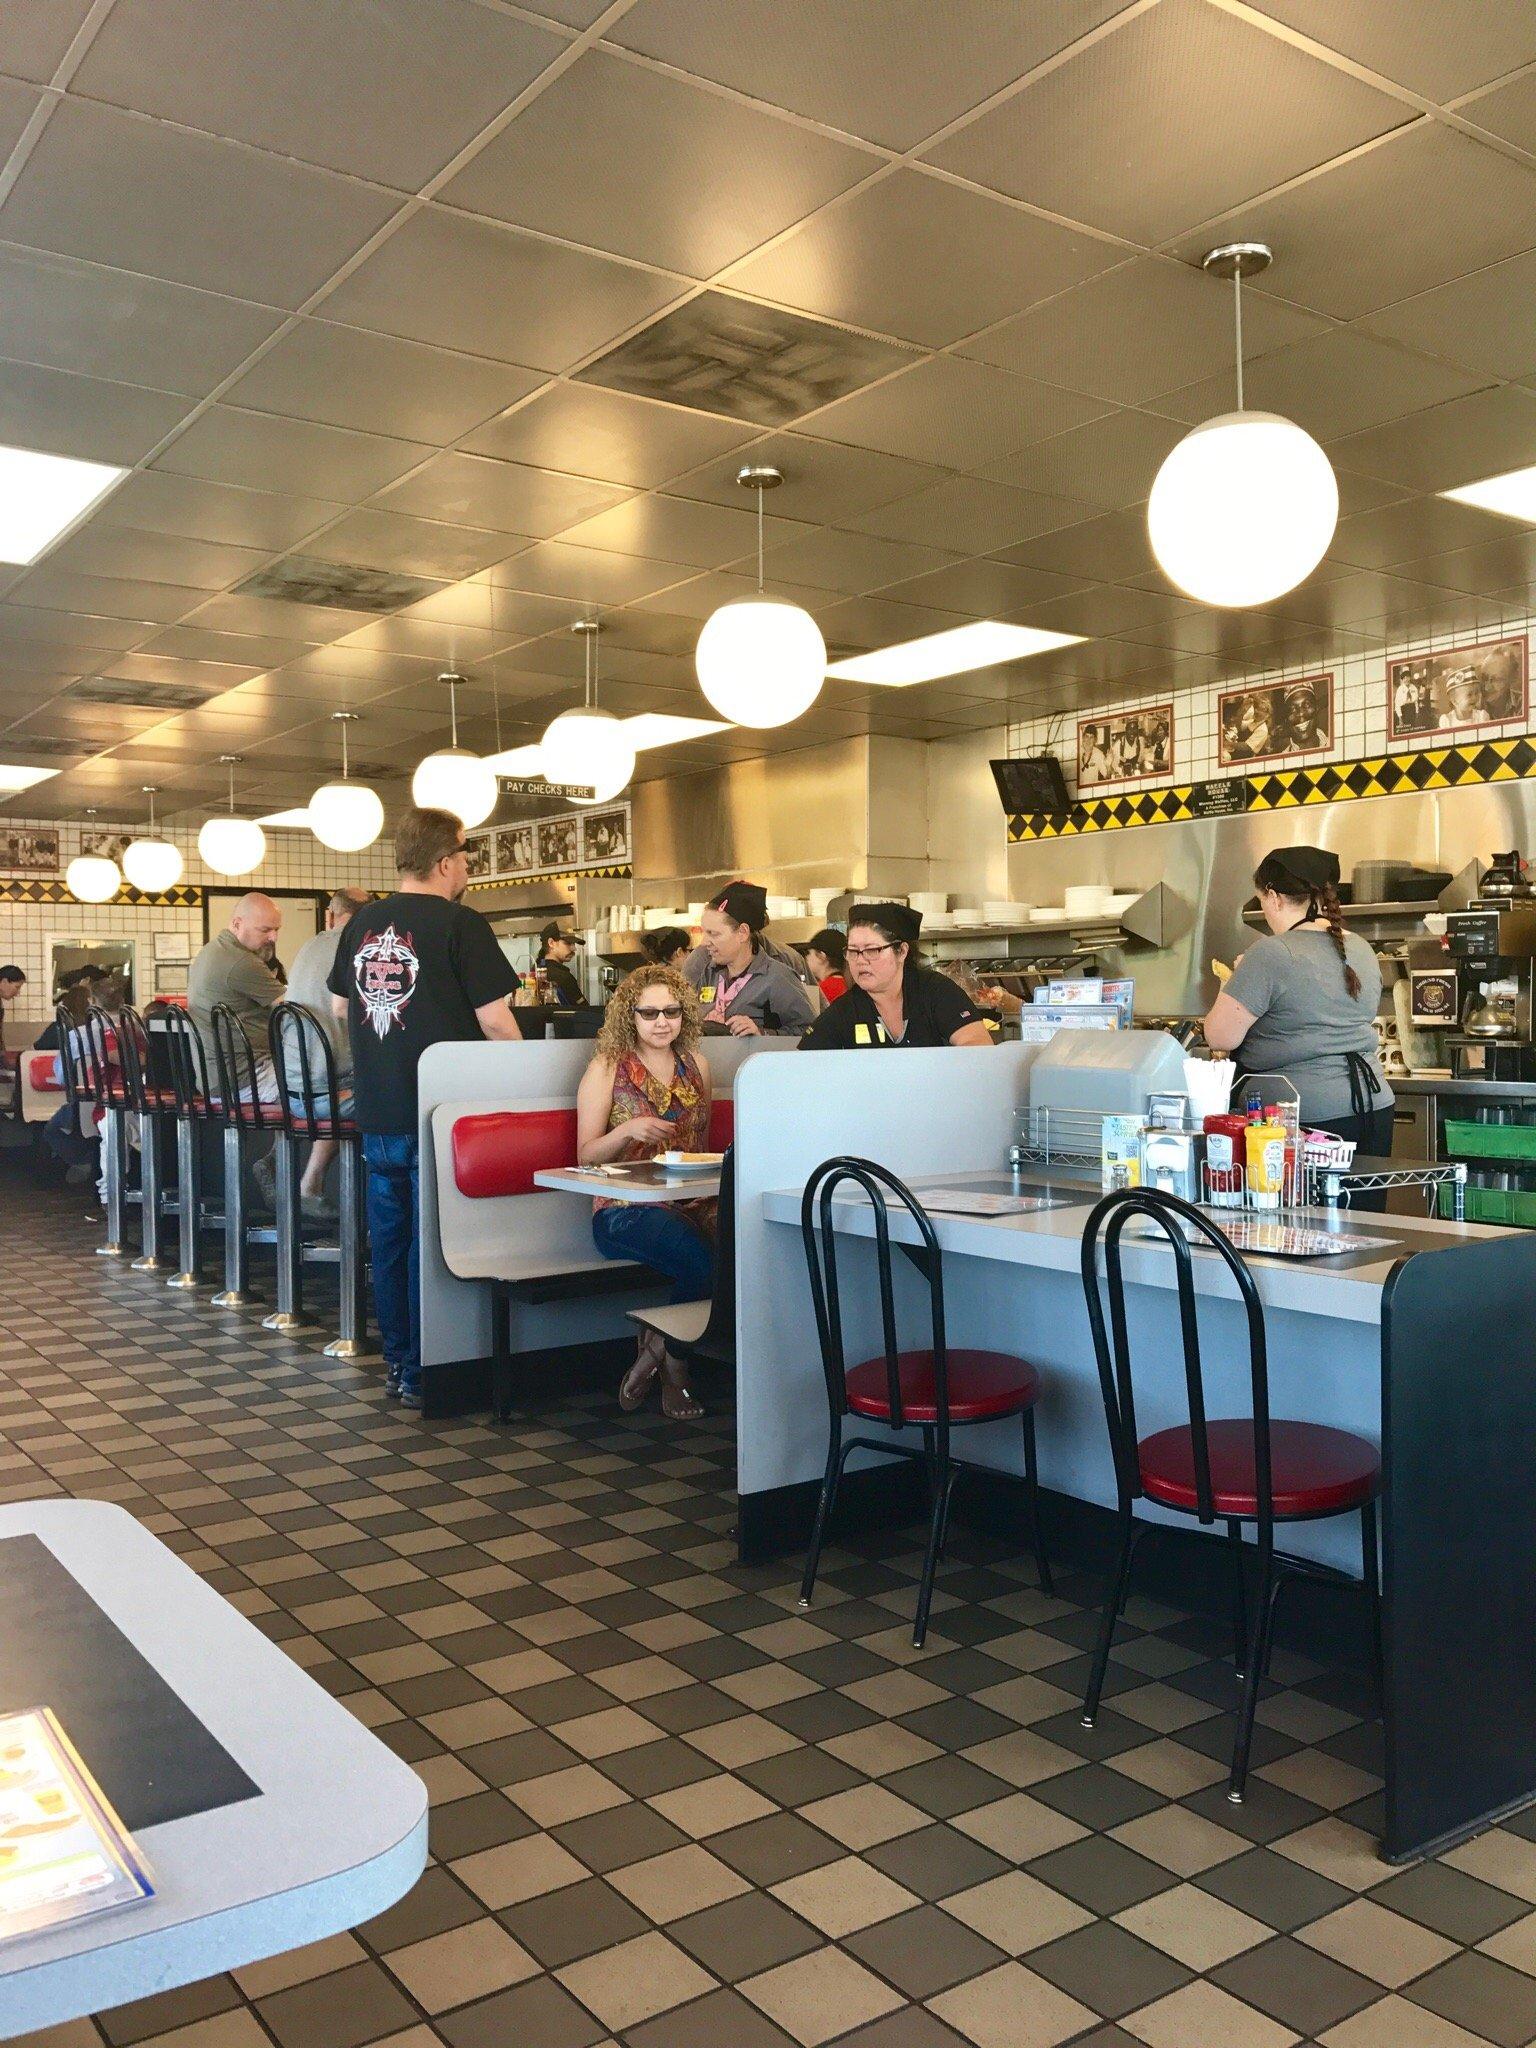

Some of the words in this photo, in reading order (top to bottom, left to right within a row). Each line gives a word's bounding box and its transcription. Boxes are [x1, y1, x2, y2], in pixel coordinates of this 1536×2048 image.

[506, 781, 525, 792] PAY
[527, 783, 563, 796] CHECKS
[565, 786, 590, 798] HERE
[1205, 781, 1231, 790] WAFFLE
[1415, 977, 1436, 990] GROUND
[1435, 978, 1452, 989] FRESH
